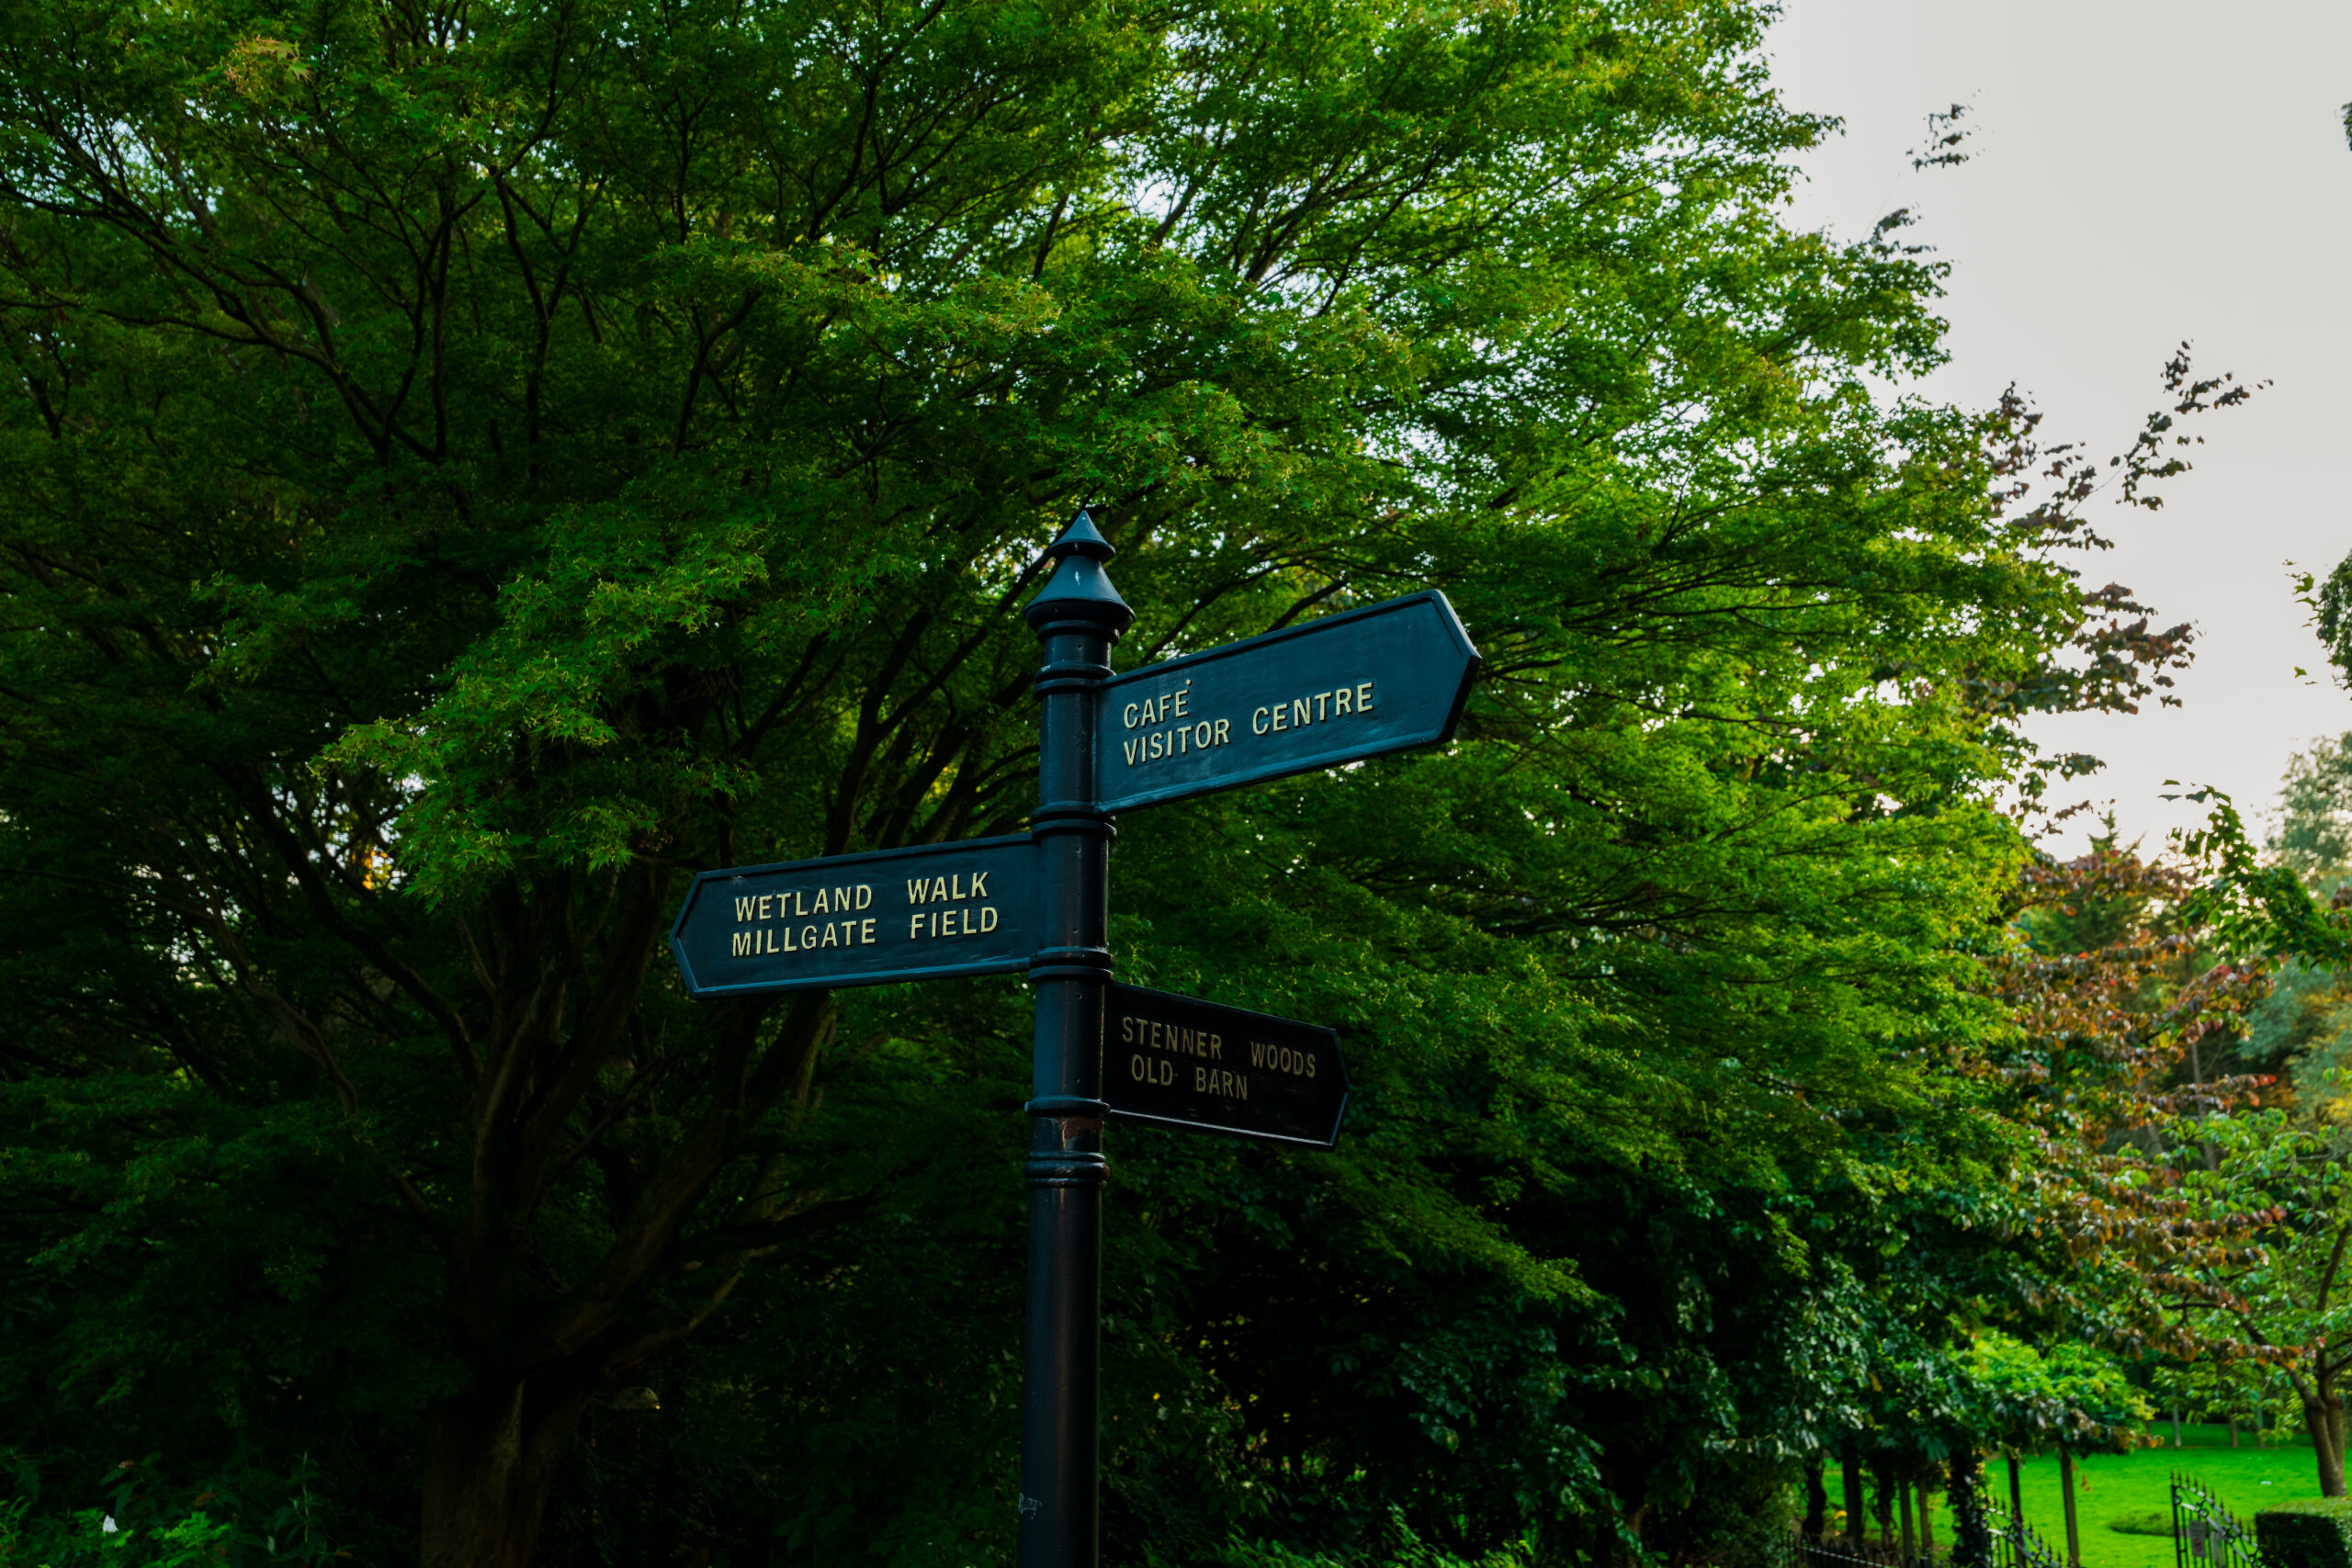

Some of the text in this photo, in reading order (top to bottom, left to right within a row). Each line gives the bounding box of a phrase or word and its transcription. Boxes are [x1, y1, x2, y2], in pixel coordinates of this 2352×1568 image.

[1123, 682, 1374, 765] VISITOR CENTRE
[735, 872, 989, 922] WETLAND WALK
[732, 907, 998, 956] MILLGATE FIELD
[1122, 1016, 1316, 1078] STENNER WOODS
[1131, 1055, 1248, 1100] OLD BARN
